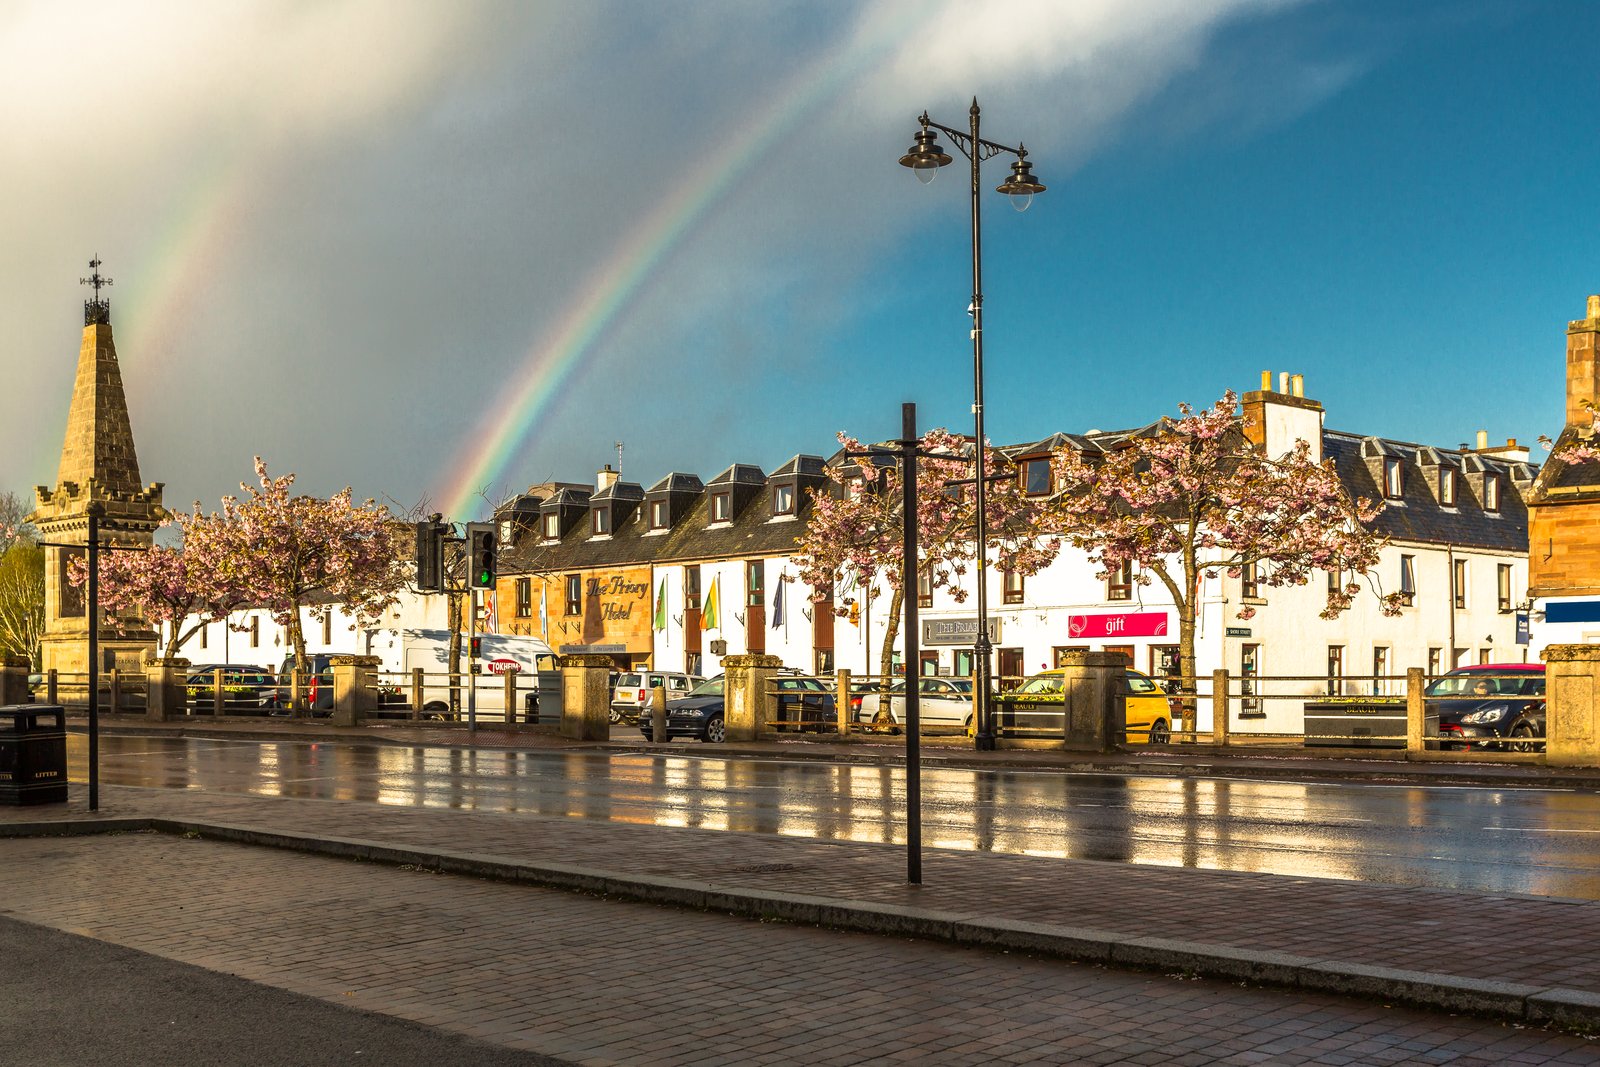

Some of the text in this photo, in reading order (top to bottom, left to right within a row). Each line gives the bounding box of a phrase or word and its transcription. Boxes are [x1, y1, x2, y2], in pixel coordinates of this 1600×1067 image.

[586, 576, 649, 600] The Priory
[600, 601, 634, 621] Hotel
[936, 621, 979, 634] THE FRIAR
[1106, 617, 1125, 635] gift
